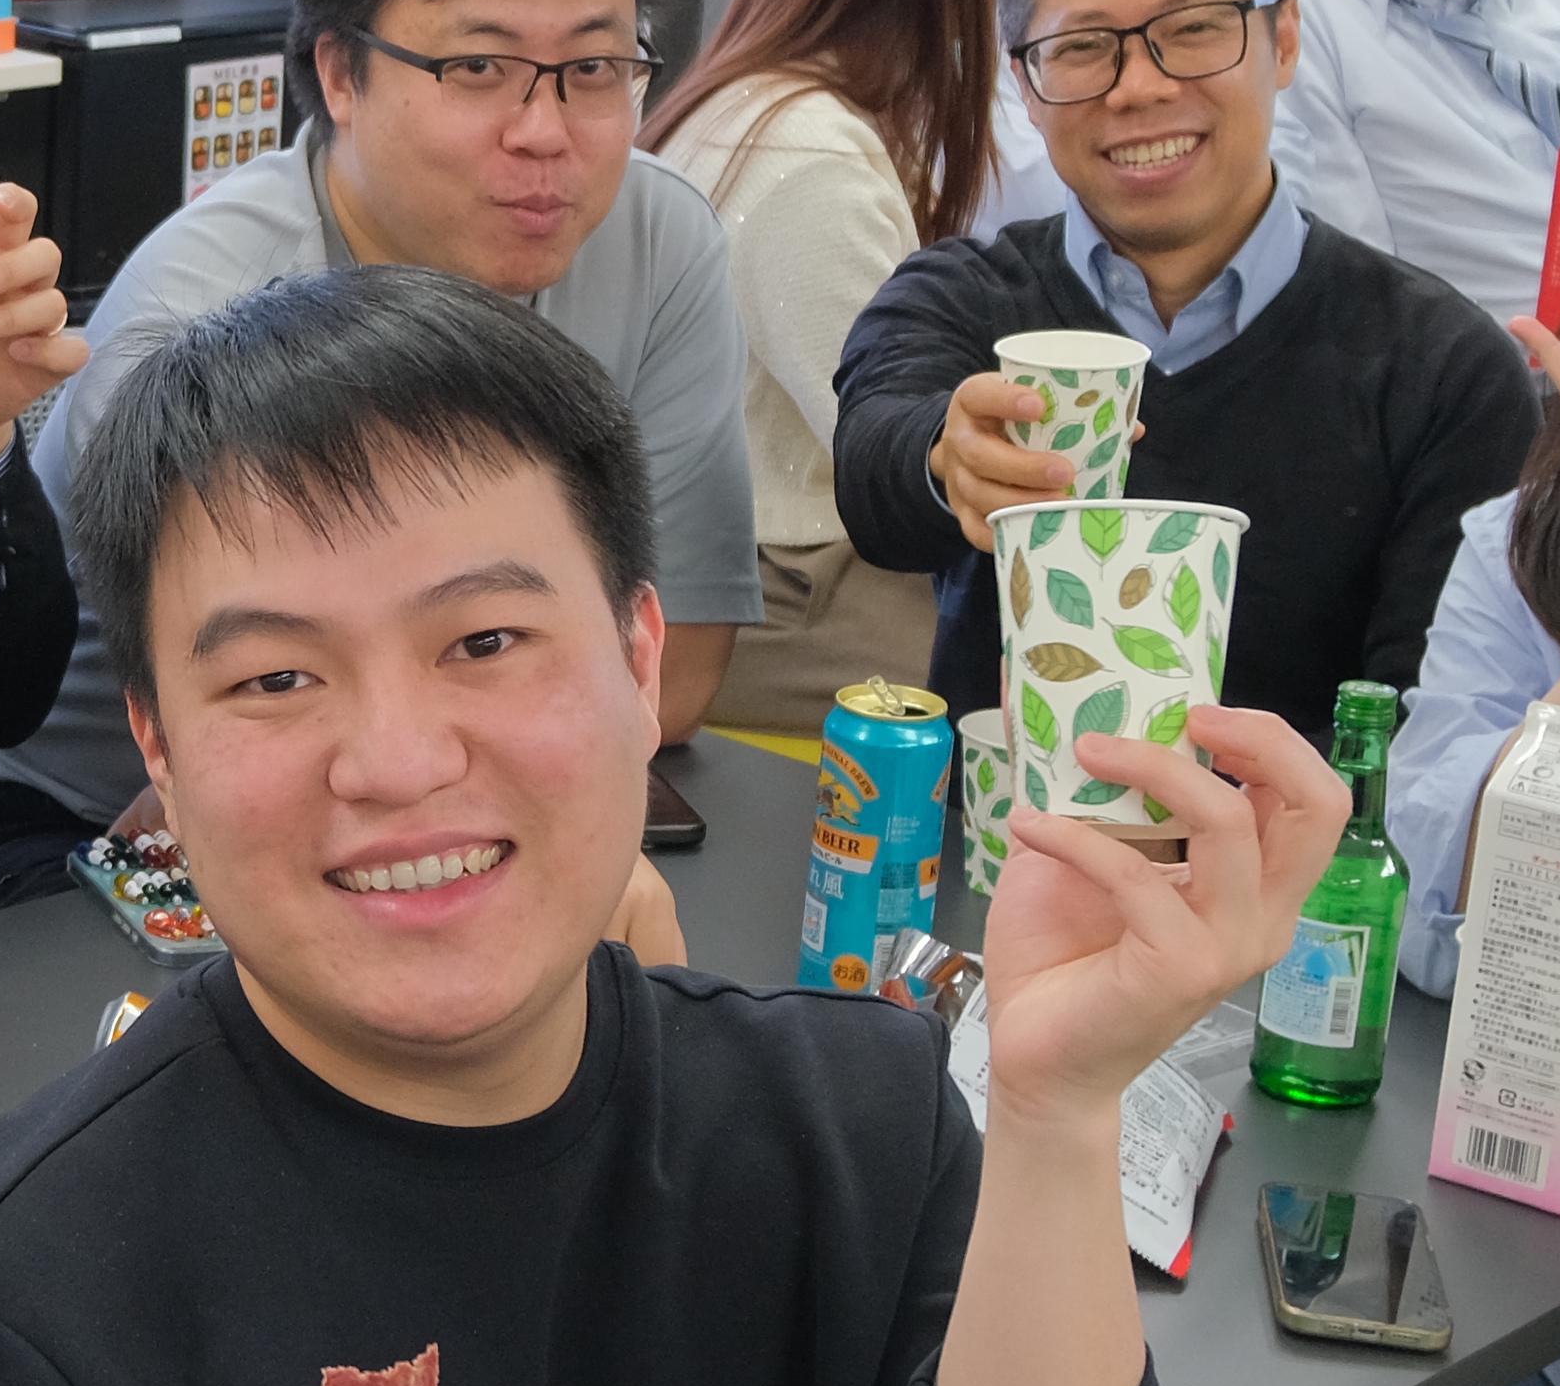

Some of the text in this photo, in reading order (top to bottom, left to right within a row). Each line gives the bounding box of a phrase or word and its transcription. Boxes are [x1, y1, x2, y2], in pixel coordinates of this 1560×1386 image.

[850, 765, 875, 798] BREW
[822, 829, 860, 855] BEER
[833, 963, 867, 983] お酒
